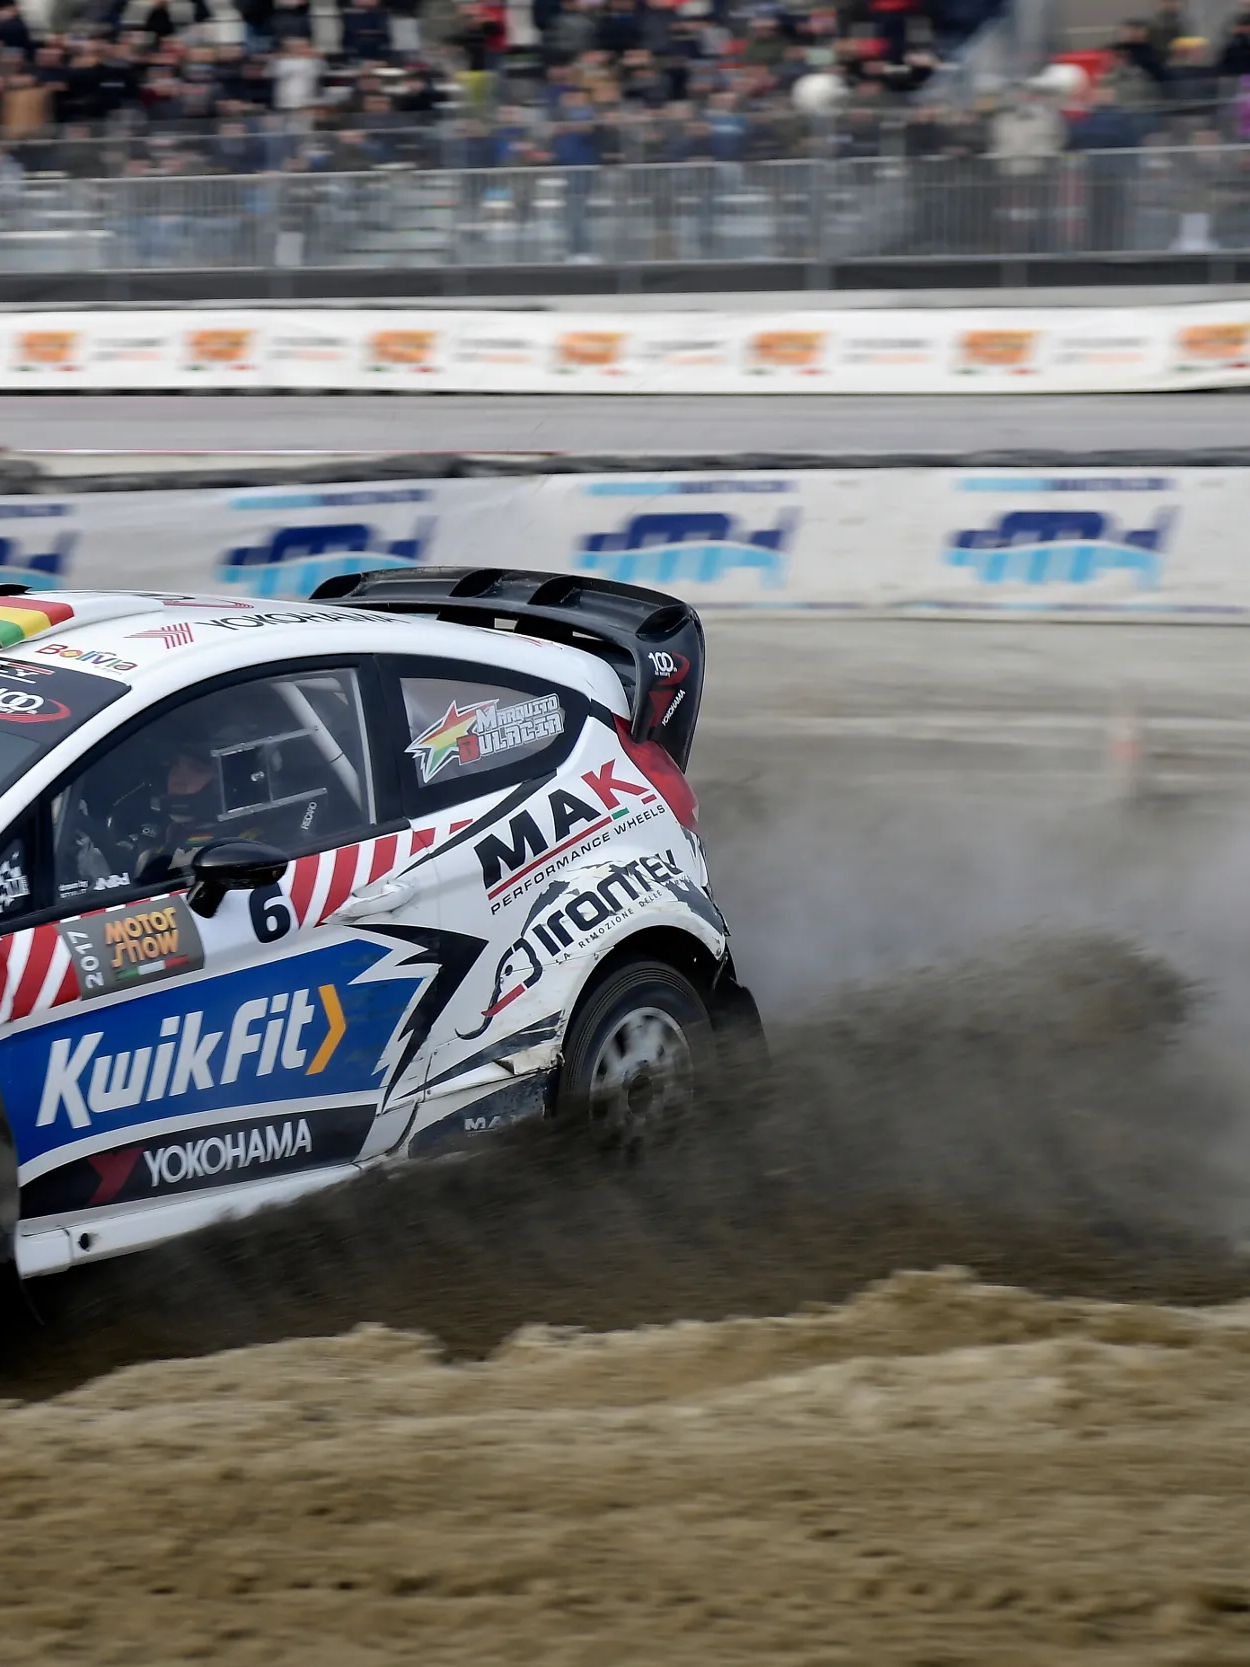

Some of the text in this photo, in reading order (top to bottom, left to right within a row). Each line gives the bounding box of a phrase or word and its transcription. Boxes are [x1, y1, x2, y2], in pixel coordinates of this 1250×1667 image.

[193, 610, 410, 631] YOKOHAMA
[661, 689, 686, 727] YOKOHAMA
[300, 801, 318, 830] RECARO
[473, 759, 651, 890] MAK
[490, 804, 666, 916] PERFORMANCE WHEELS
[248, 883, 292, 944] 6
[577, 907, 635, 949] RIMOZIONE
[637, 889, 664, 908] DELLE
[66, 930, 105, 989] 2017
[142, 1118, 313, 1188] YOKOHAMA
